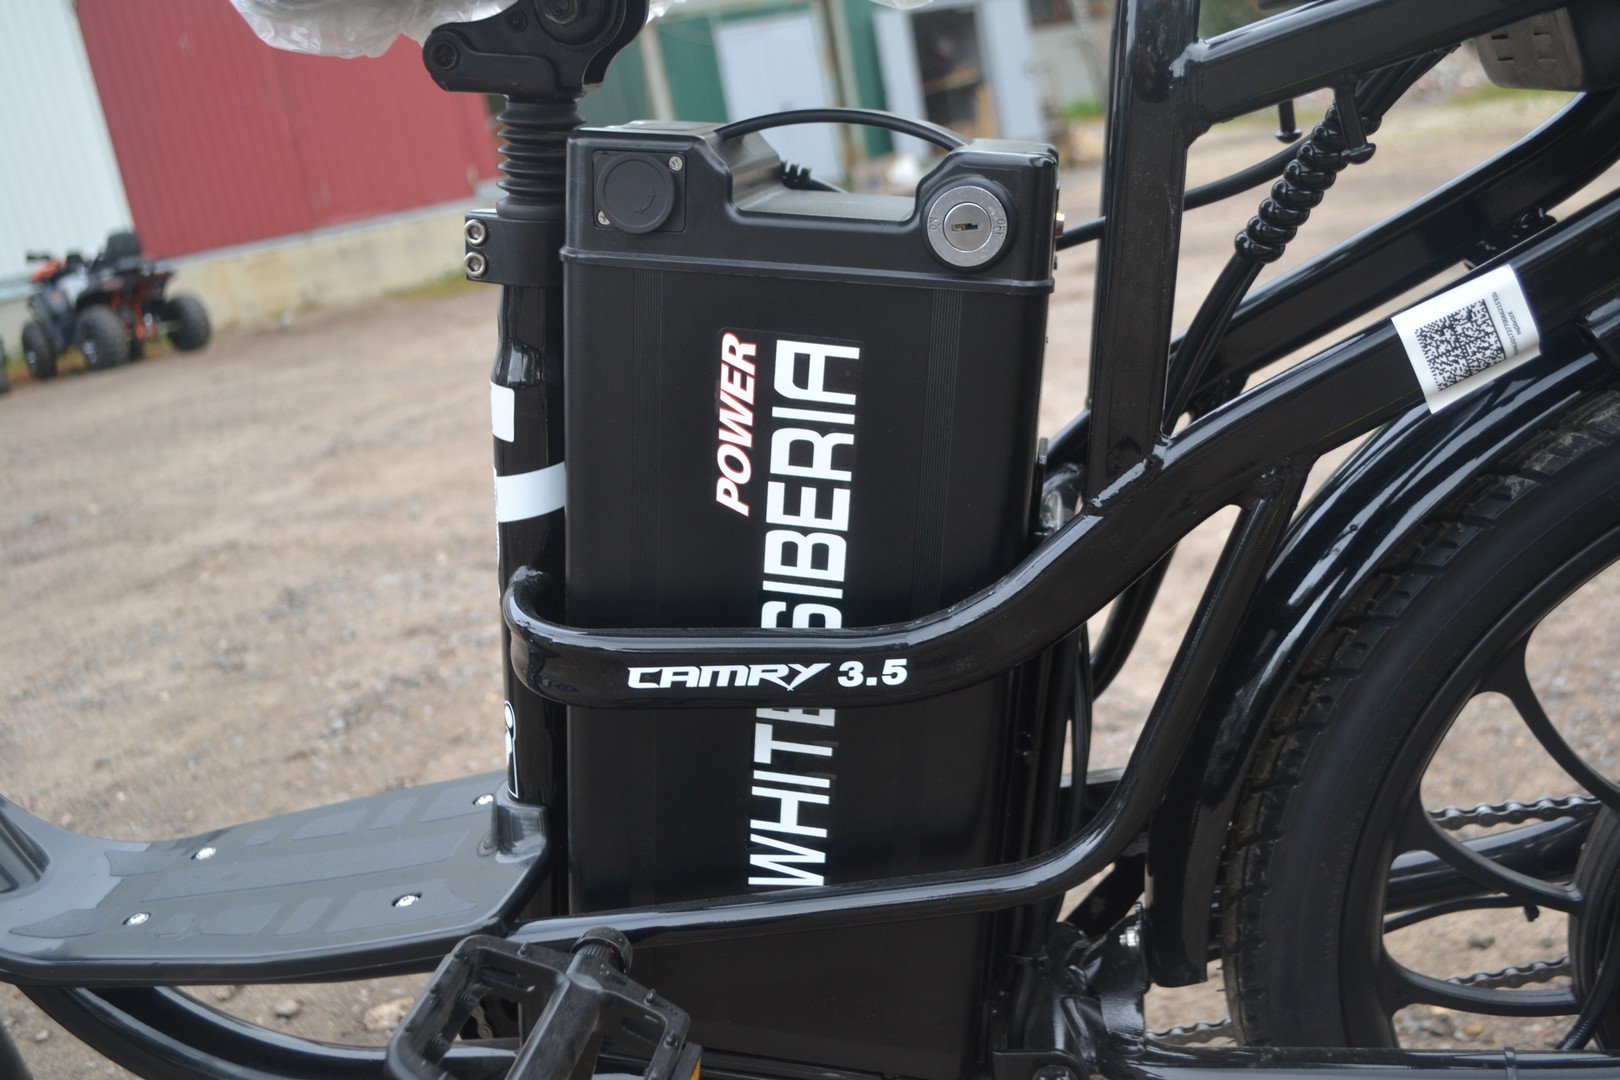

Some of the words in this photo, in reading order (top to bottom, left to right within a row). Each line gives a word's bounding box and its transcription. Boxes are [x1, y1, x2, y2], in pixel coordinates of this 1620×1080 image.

[715, 331, 758, 518] POWER
[760, 339, 861, 629] SIBERIA
[627, 662, 832, 691] CAMRY
[836, 658, 909, 688] 3.5
[747, 707, 836, 887] WHIT
